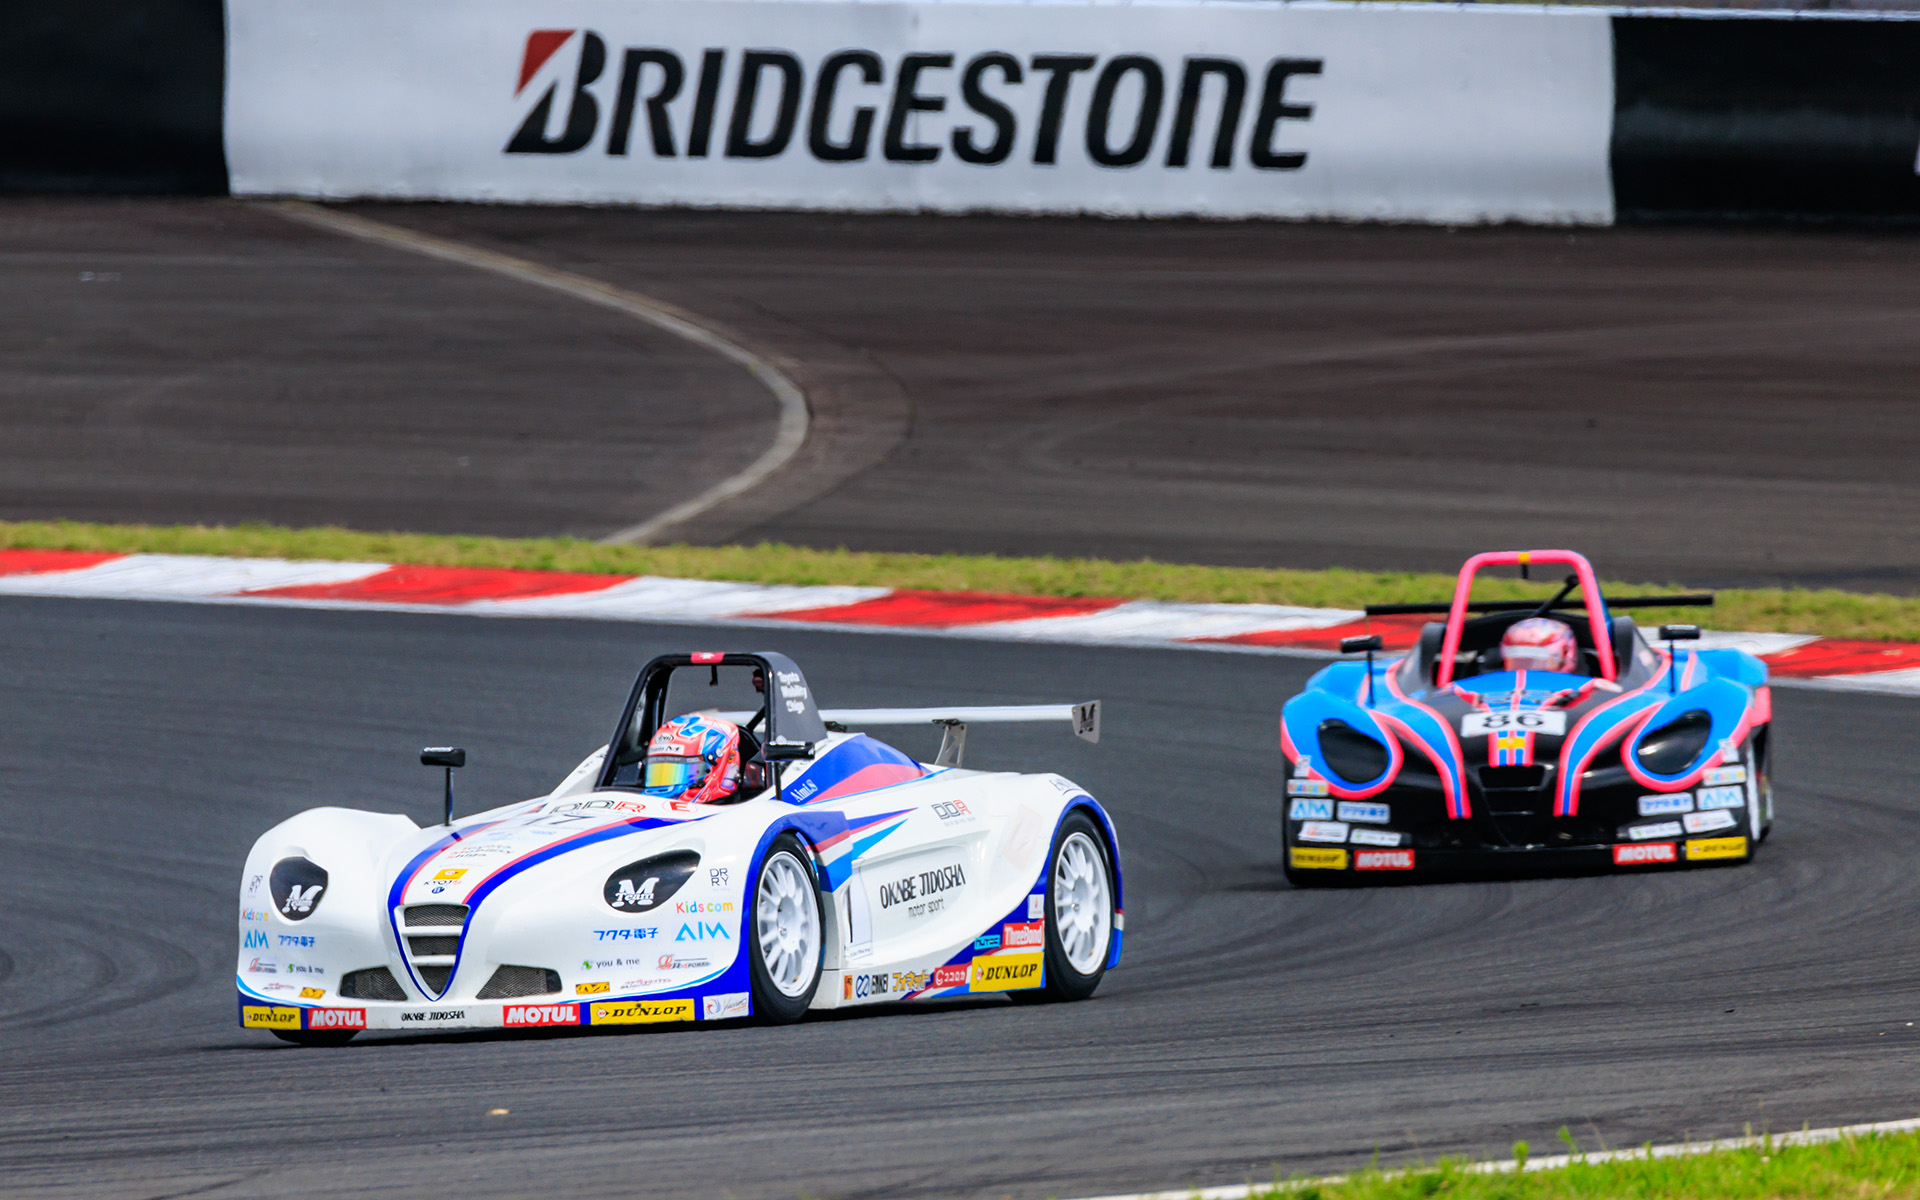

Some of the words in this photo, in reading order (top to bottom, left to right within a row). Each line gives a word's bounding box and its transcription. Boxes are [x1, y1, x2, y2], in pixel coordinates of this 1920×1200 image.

[504, 29, 1323, 170] BRIDGESTONE
[1482, 713, 1544, 728] 86
[931, 799, 972, 820] DDR
[1358, 852, 1412, 868] MOTUL
[1617, 845, 1674, 861] MOTUL
[880, 876, 917, 909] OKABE
[919, 863, 966, 896] JIDOSHA
[593, 927, 659, 941] フクタ電子
[1004, 925, 1042, 945] ThreeBond
[596, 959, 613, 969] you
[985, 964, 1038, 980] DUNLOP
[252, 1013, 296, 1023] DUNLOP
[311, 1010, 364, 1027] MOTUL
[506, 1007, 577, 1024] MOTUL
[612, 1006, 687, 1017] DUNLOP
